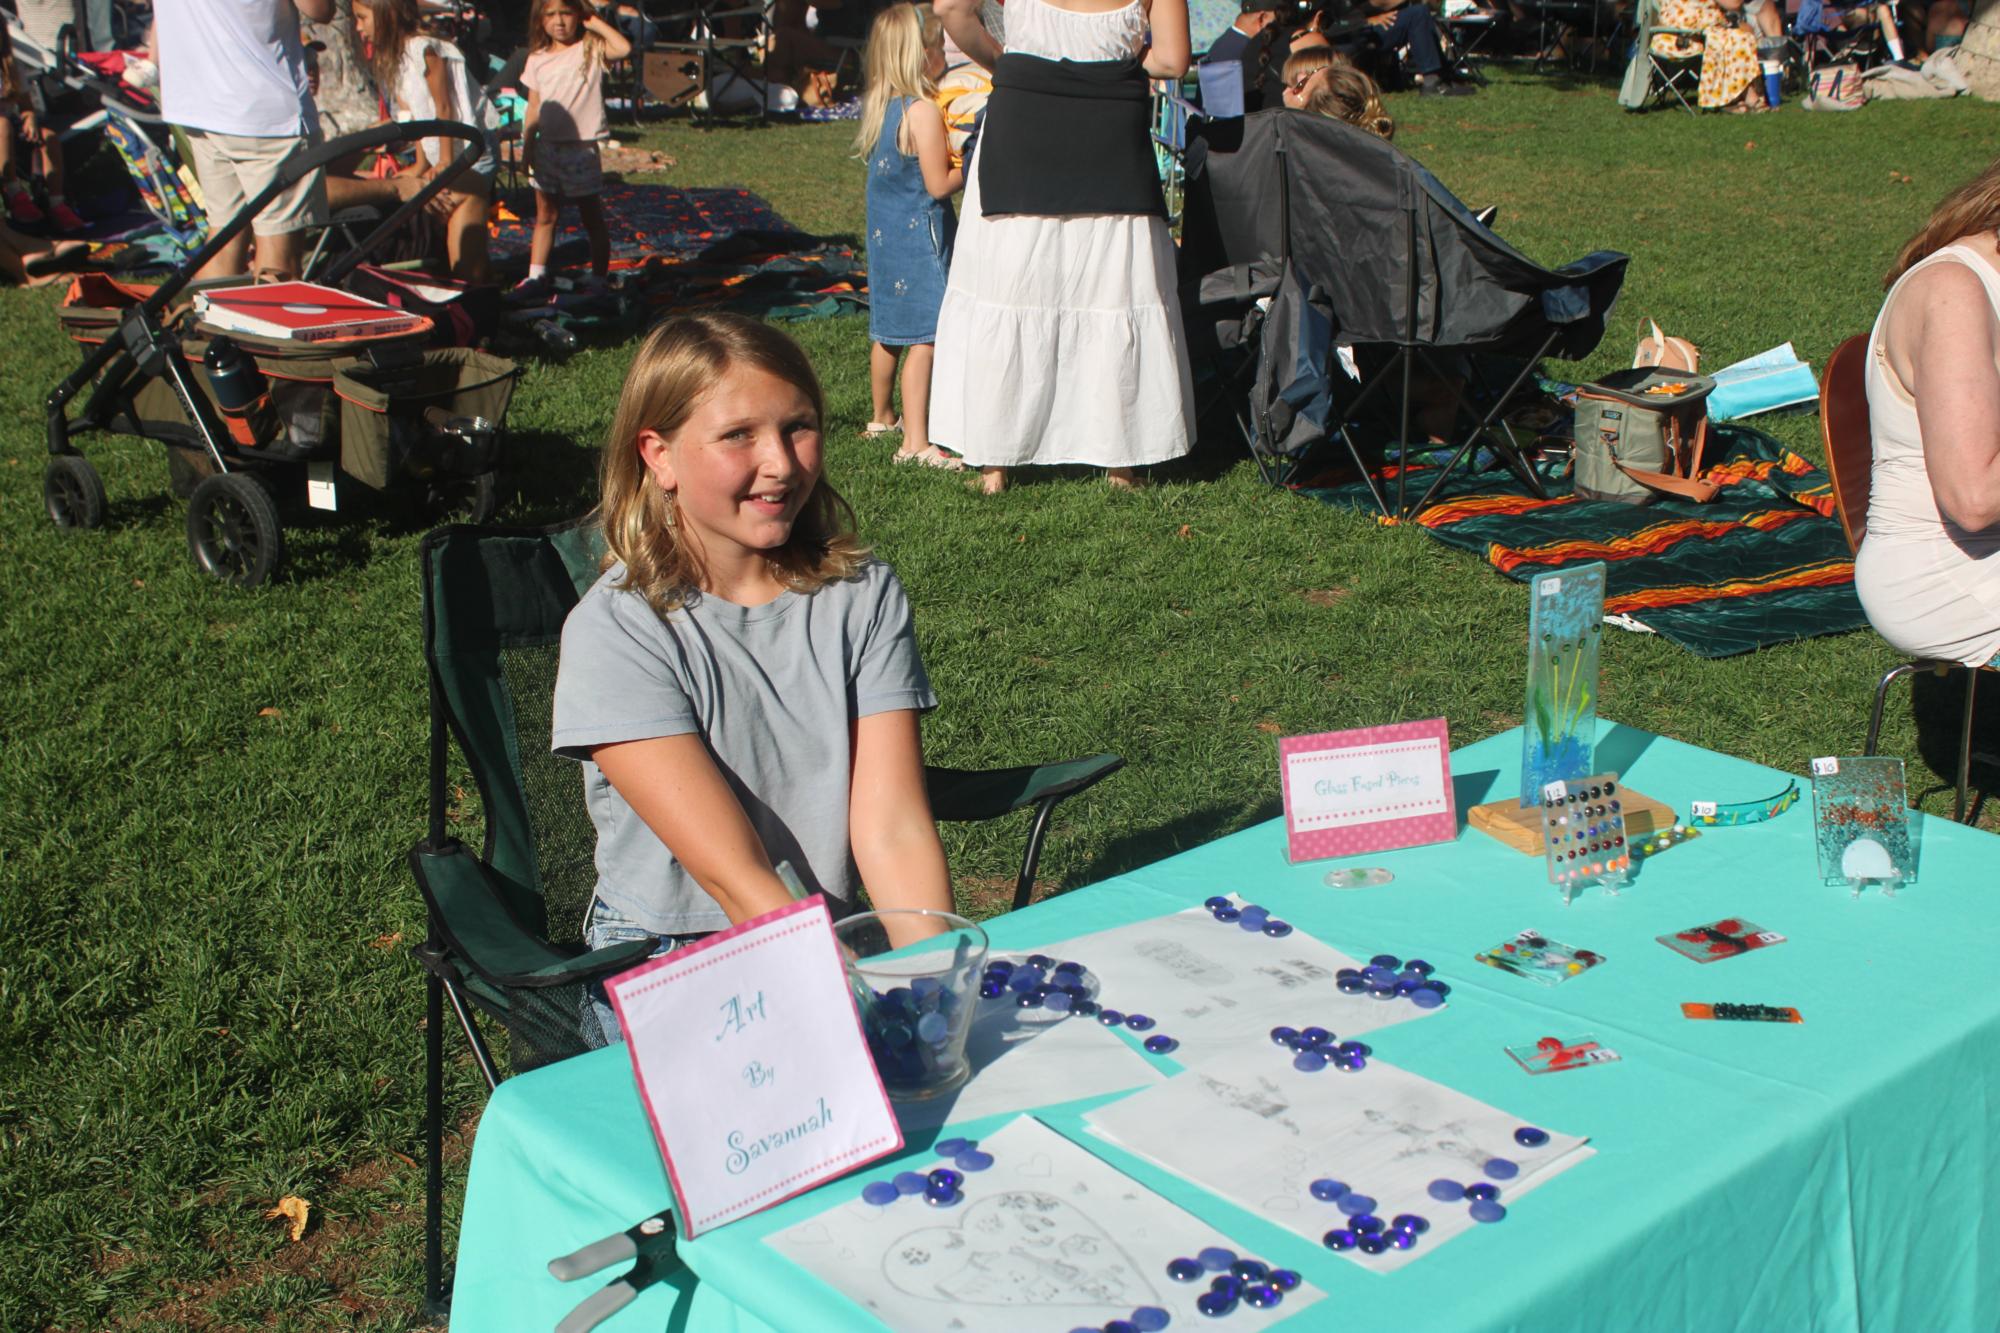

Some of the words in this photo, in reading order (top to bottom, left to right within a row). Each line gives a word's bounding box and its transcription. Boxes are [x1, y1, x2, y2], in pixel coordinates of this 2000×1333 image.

[1314, 778, 1347, 796] Glass
[715, 990, 767, 1042] Art
[742, 1060, 775, 1088] By
[725, 1096, 834, 1175] Savannah
